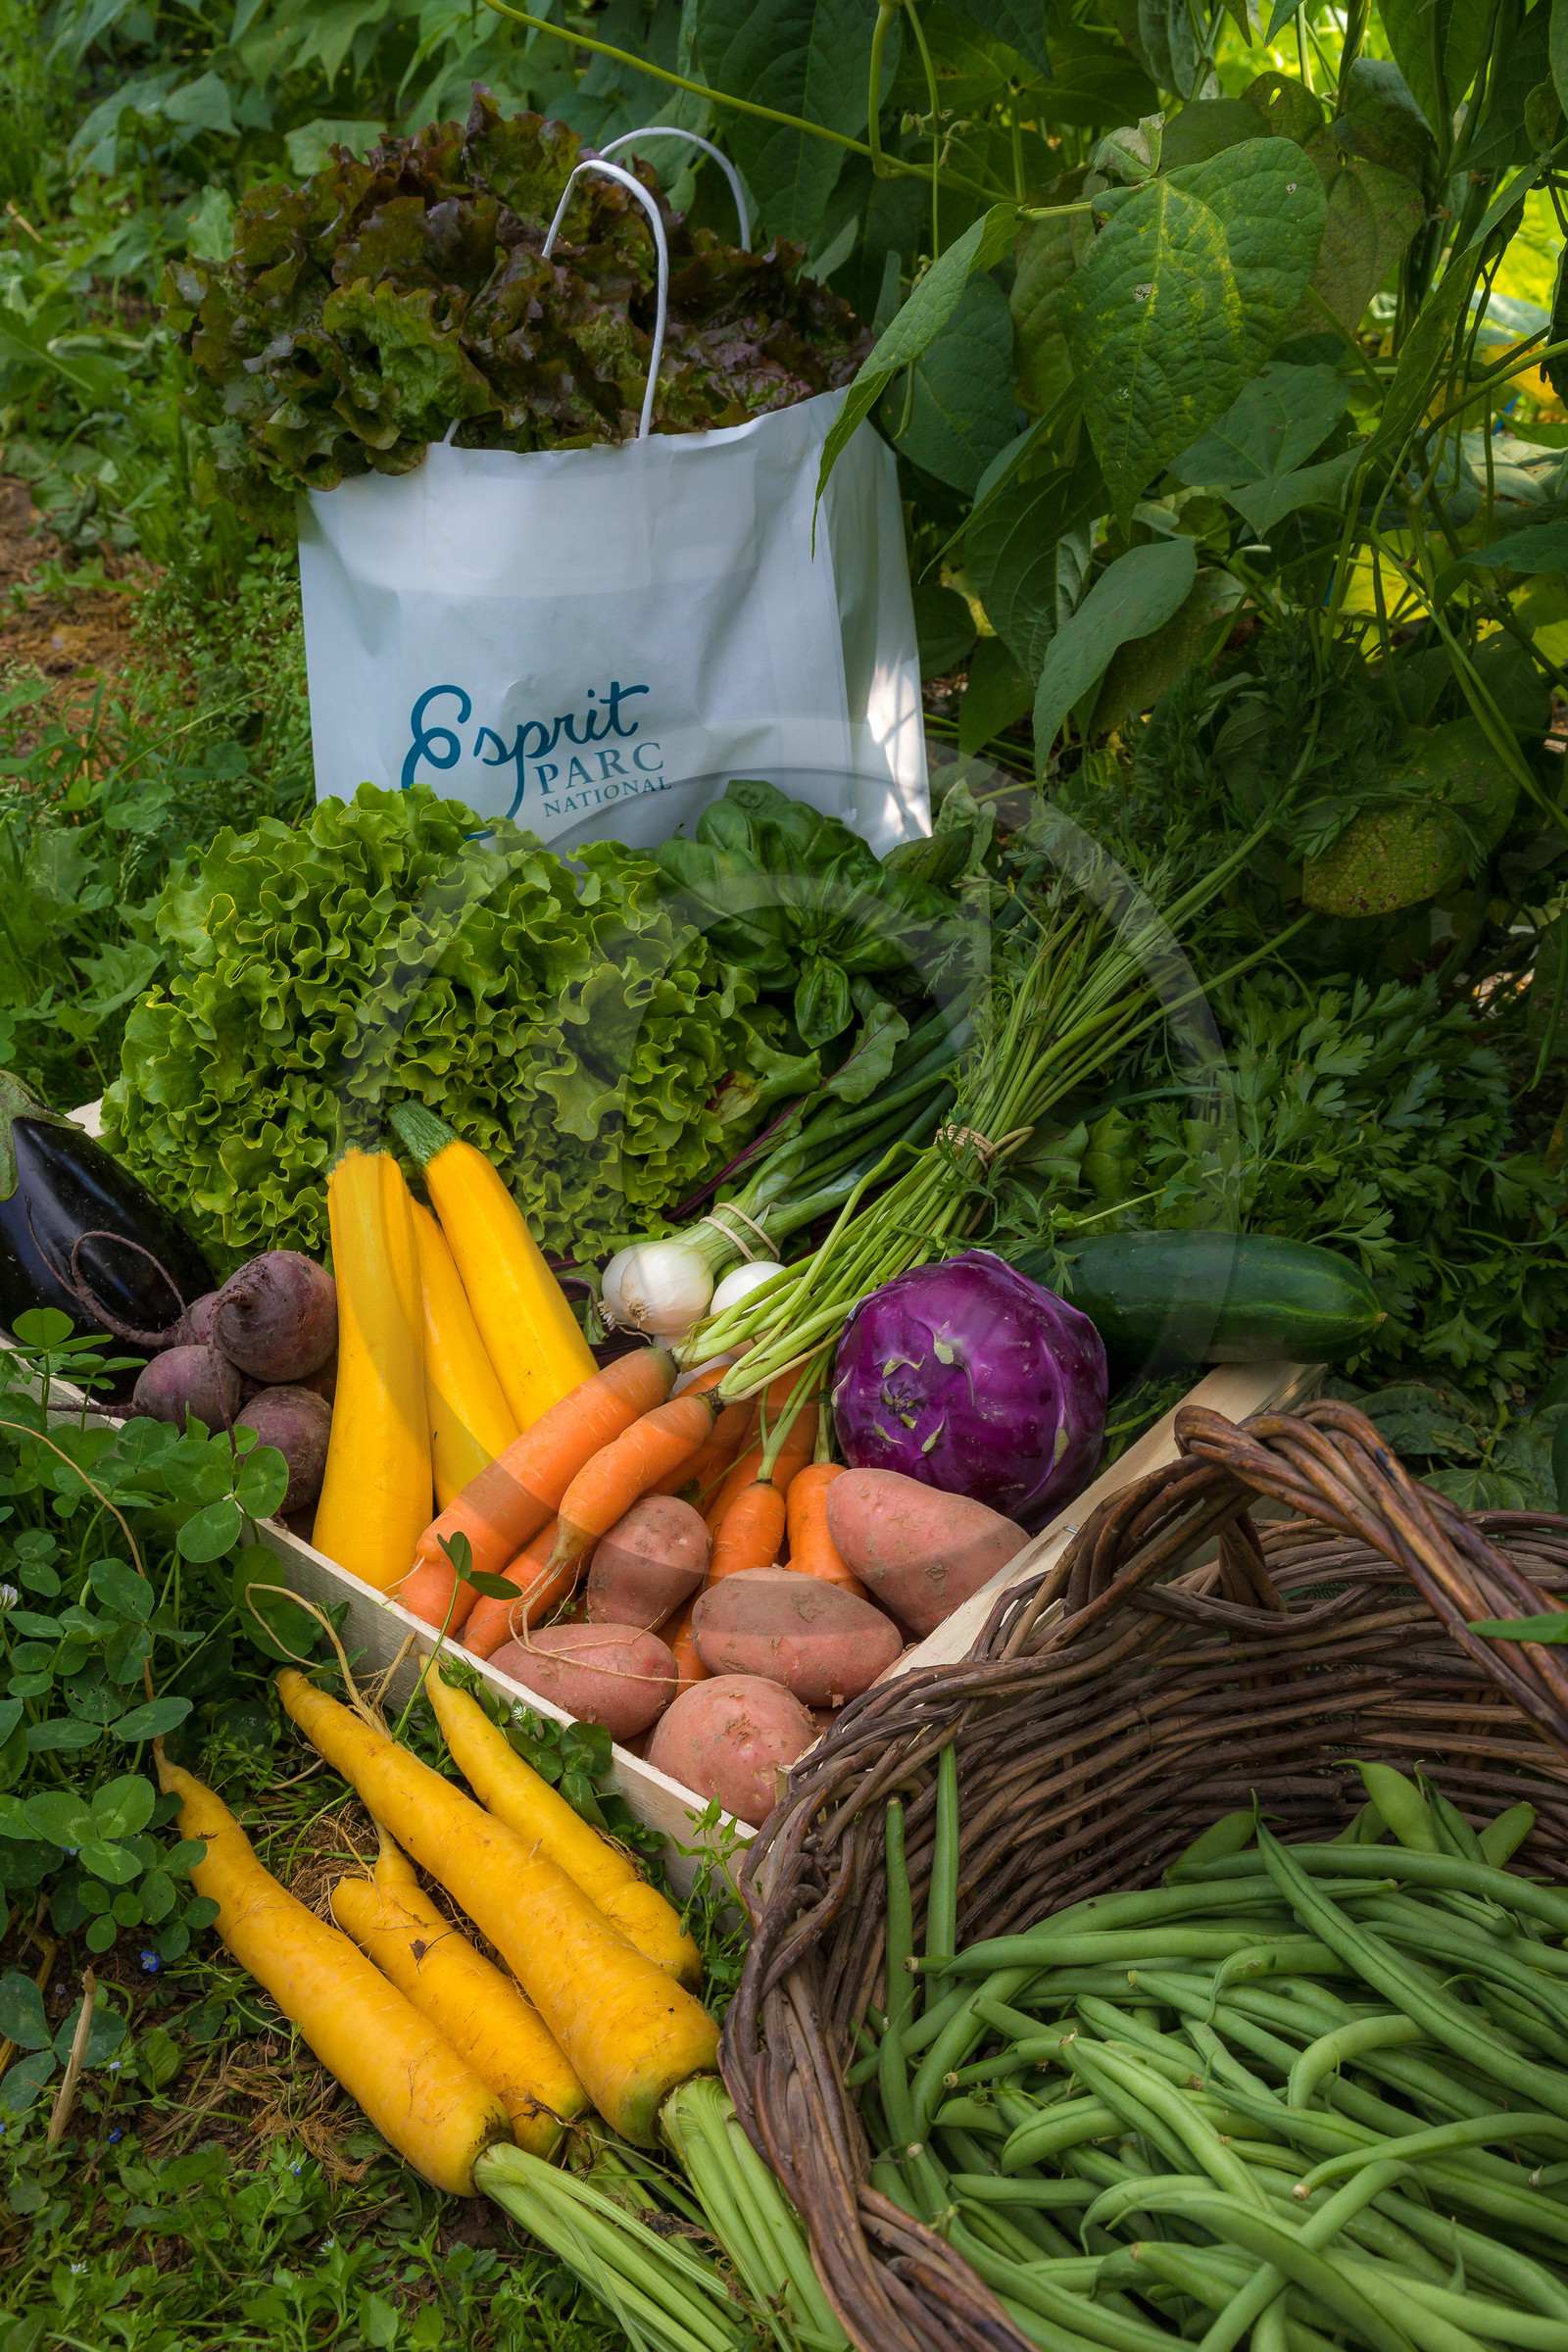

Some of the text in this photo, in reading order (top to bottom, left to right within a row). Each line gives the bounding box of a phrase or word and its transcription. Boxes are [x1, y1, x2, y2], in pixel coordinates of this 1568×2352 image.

[401, 681, 650, 841] Esprit
[533, 742, 664, 797] PARC
[541, 775, 672, 817] NATIONAL
